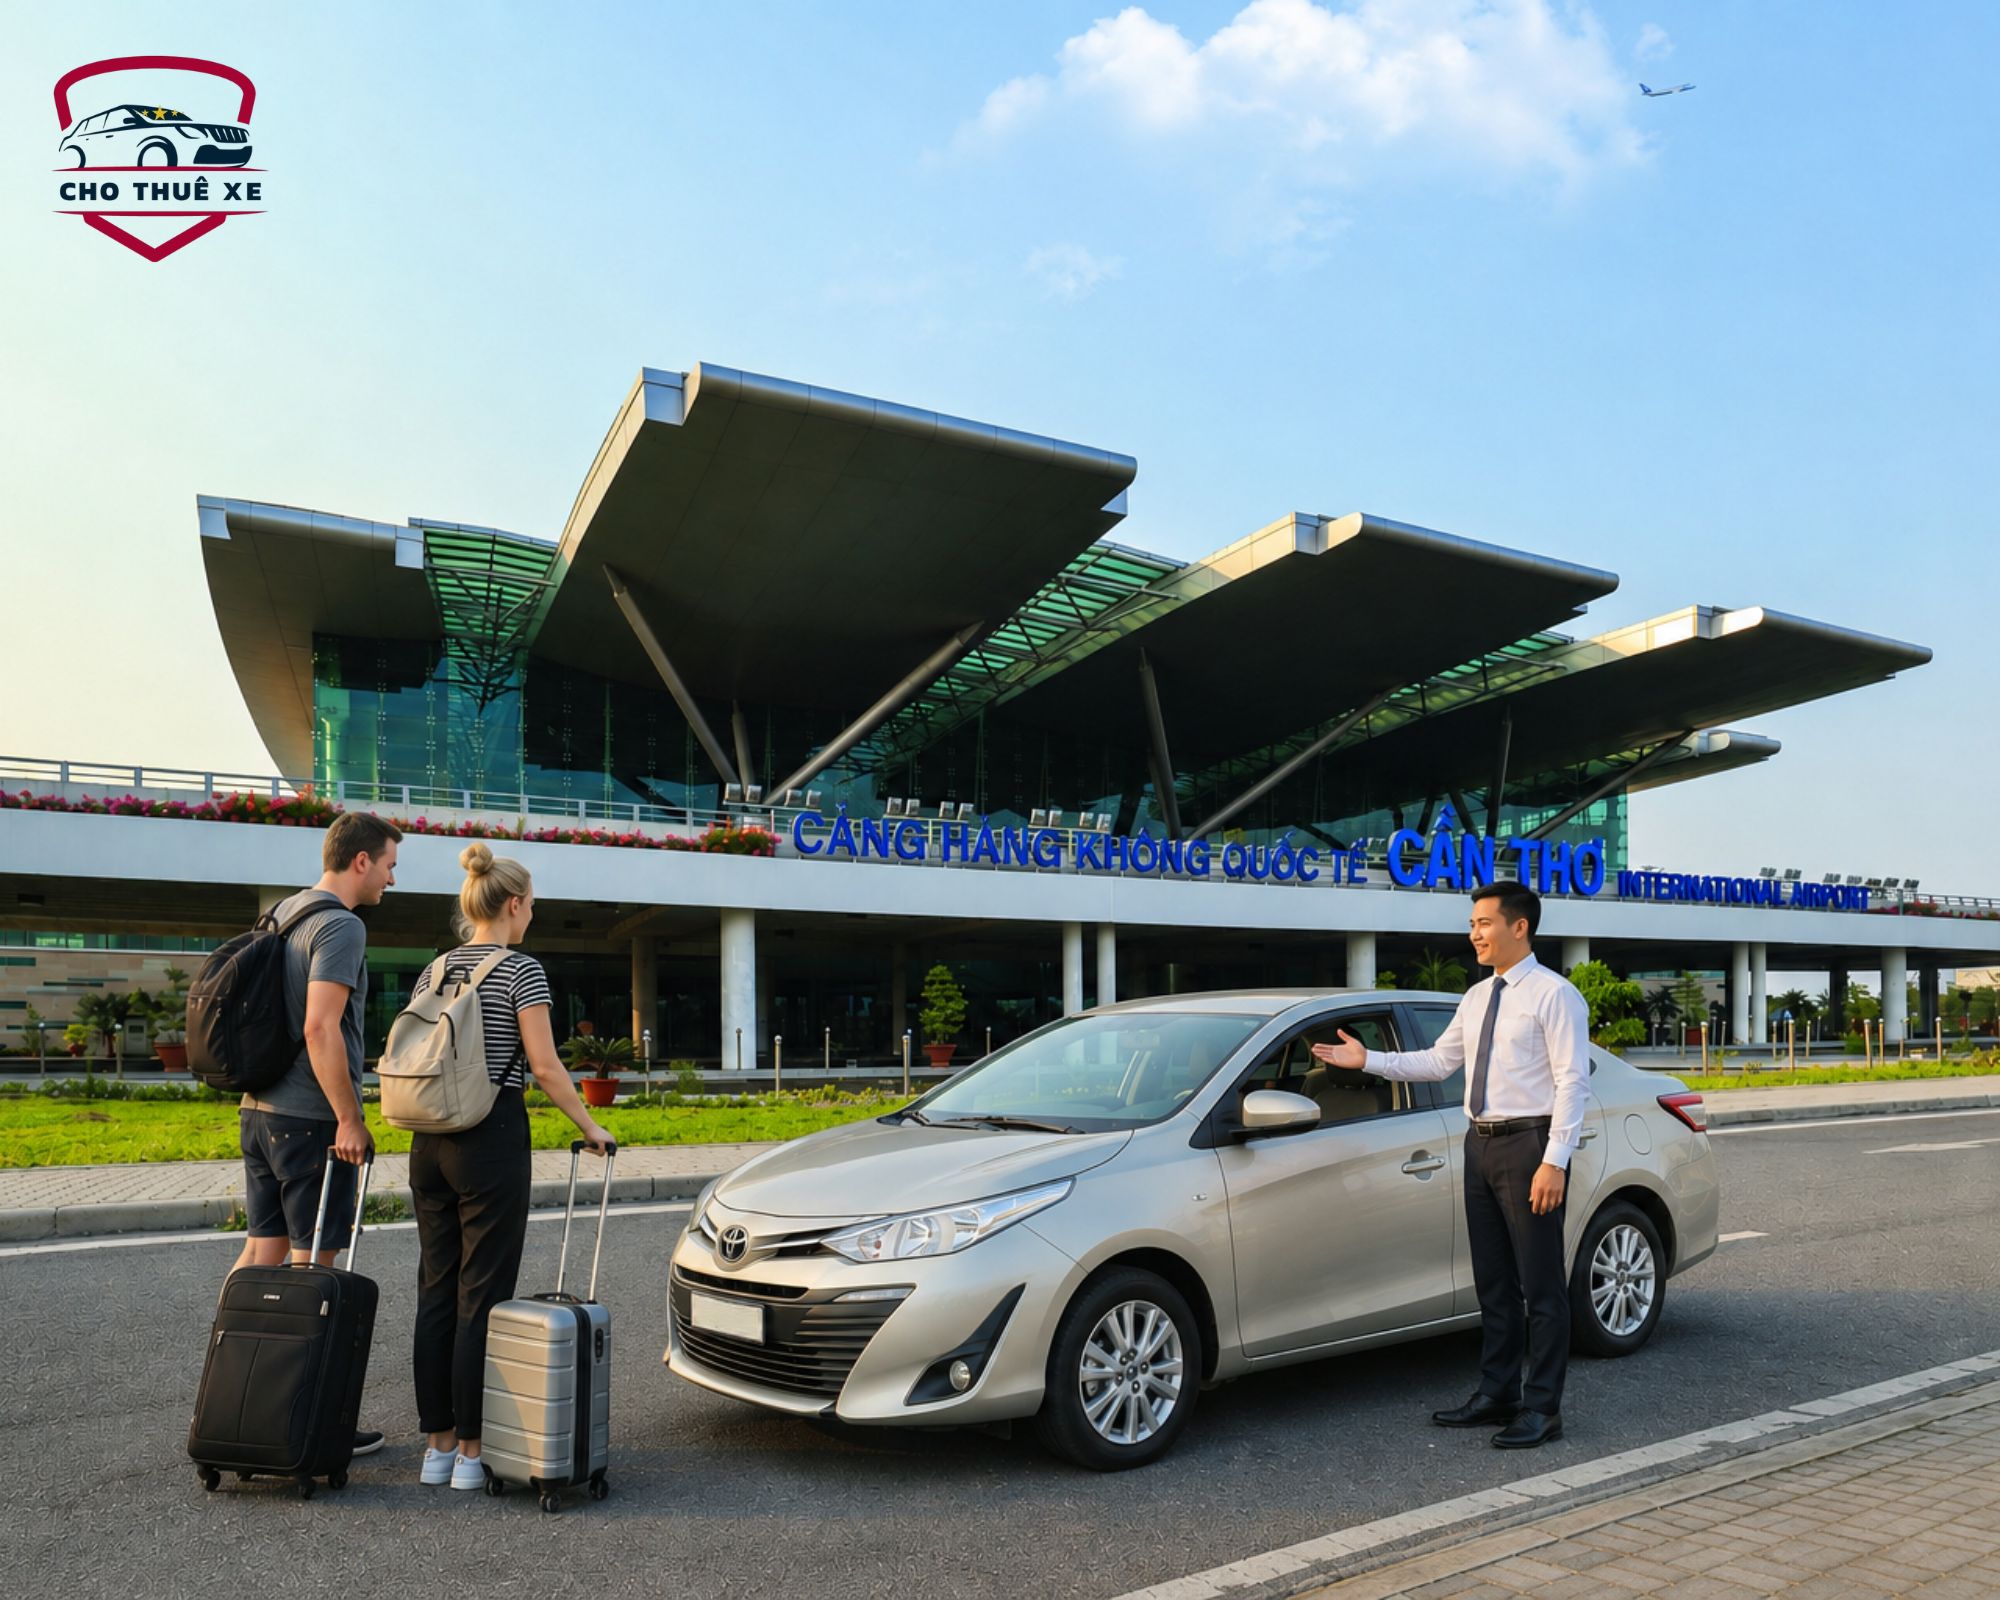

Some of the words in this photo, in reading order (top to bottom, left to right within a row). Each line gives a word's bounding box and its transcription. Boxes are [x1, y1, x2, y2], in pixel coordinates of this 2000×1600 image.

[1074, 828, 1210, 876] KHÔNG
[1222, 830, 1320, 881] QUỐC
[1330, 838, 1368, 884] TẾ
[1387, 801, 1495, 890] CẦN
[1508, 836, 1606, 896] THƠ
[1617, 870, 1787, 905] INTERNATIONAL
[1790, 881, 1871, 912] AIRPORT
